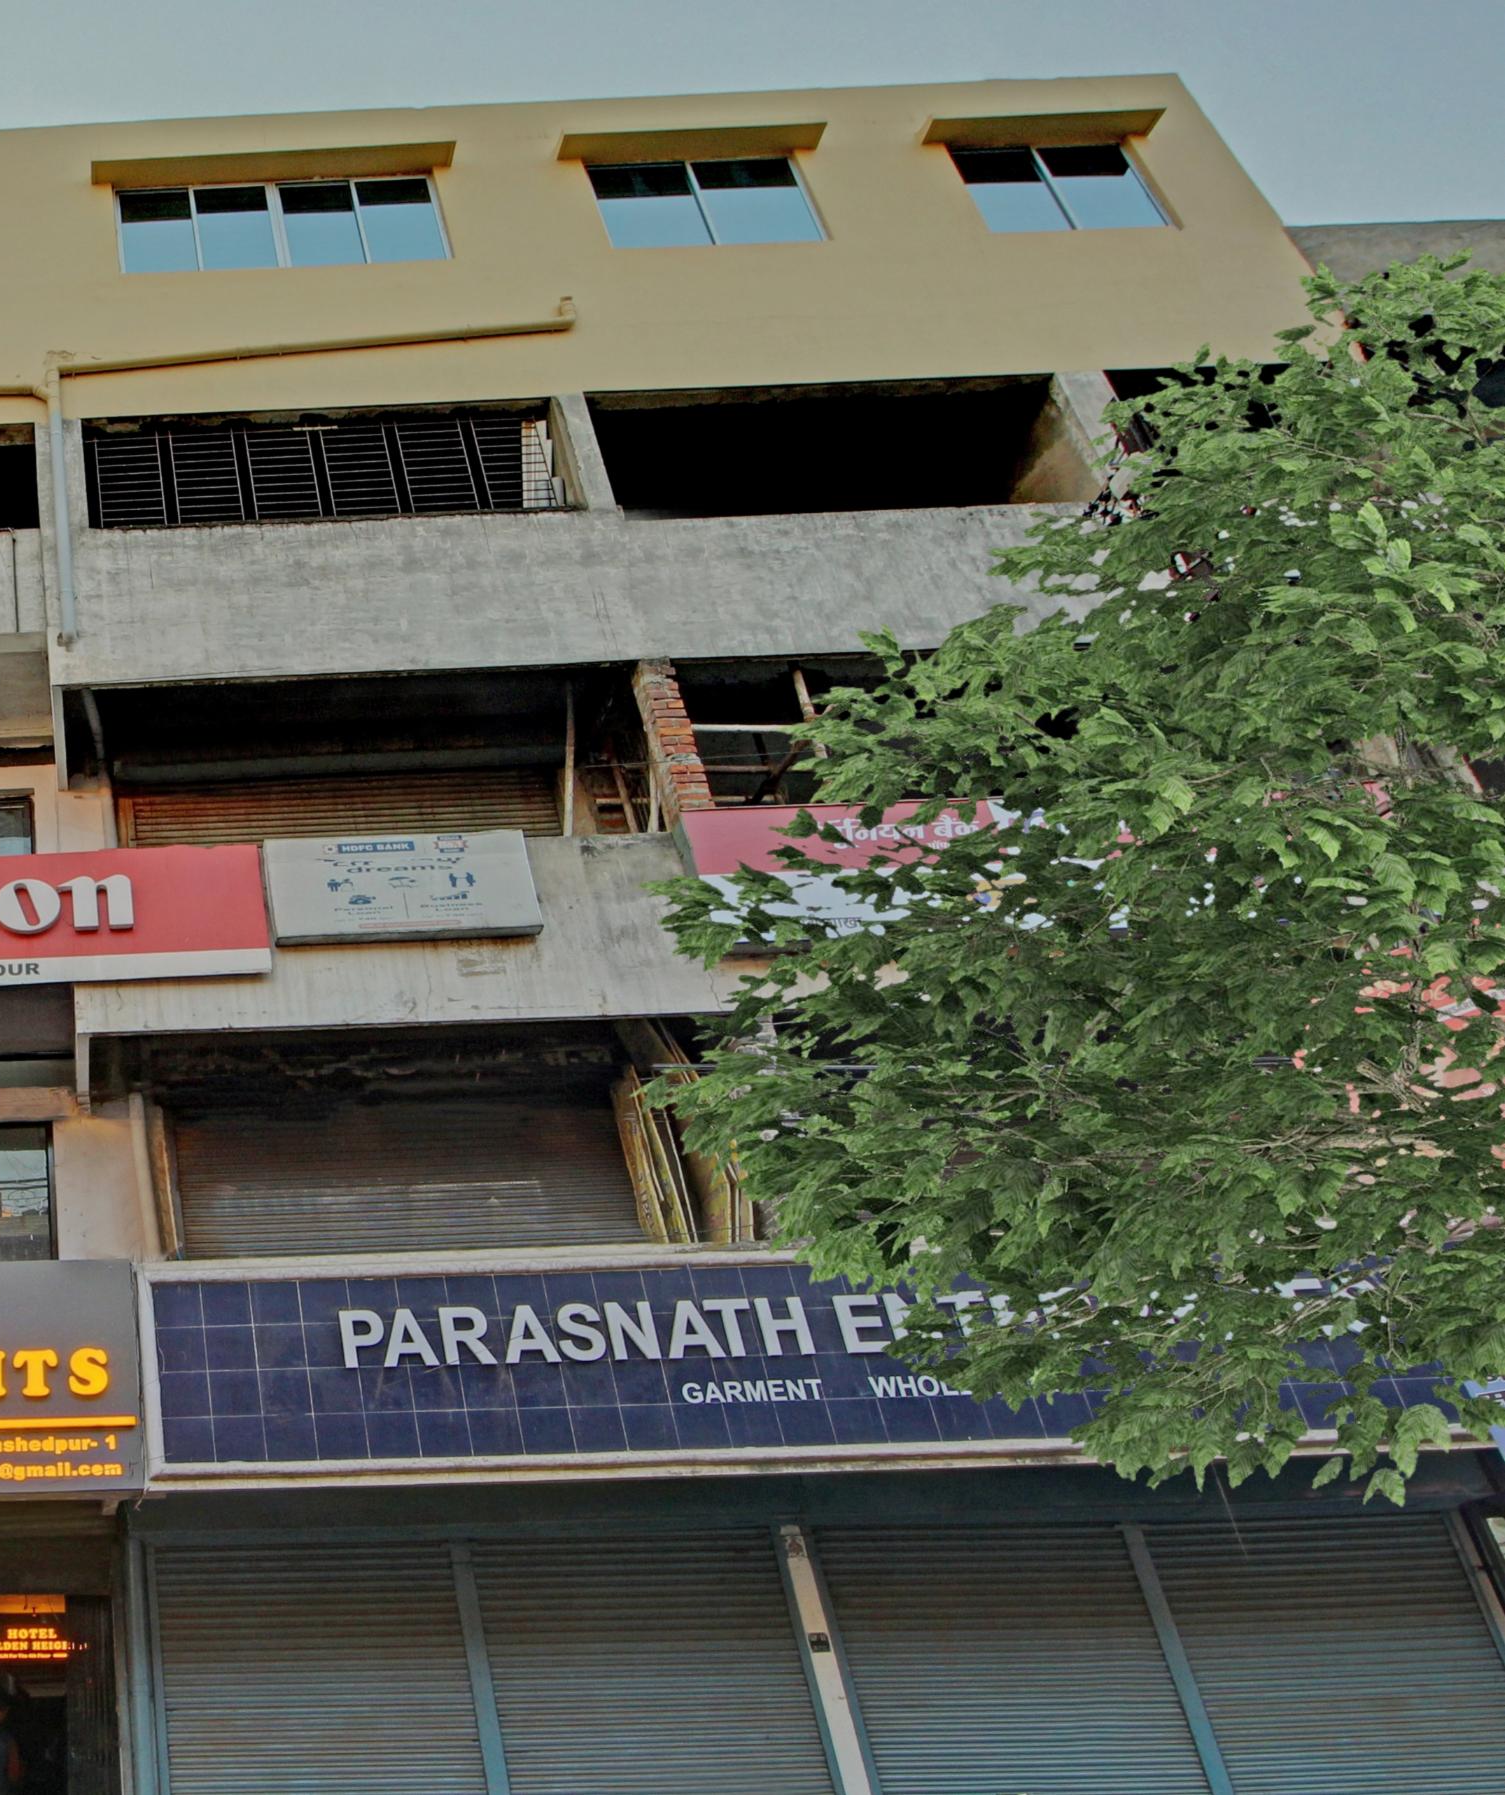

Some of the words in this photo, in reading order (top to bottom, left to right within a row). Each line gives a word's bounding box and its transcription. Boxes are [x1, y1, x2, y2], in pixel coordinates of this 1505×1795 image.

[341, 842, 375, 852] HDFC
[376, 842, 410, 851] BANK
[339, 1295, 818, 1370] PARASNATH
[681, 1378, 823, 1406] GARMENT
[104, 1434, 117, 1451] 1
[7, 1628, 58, 1640] HOTEL
